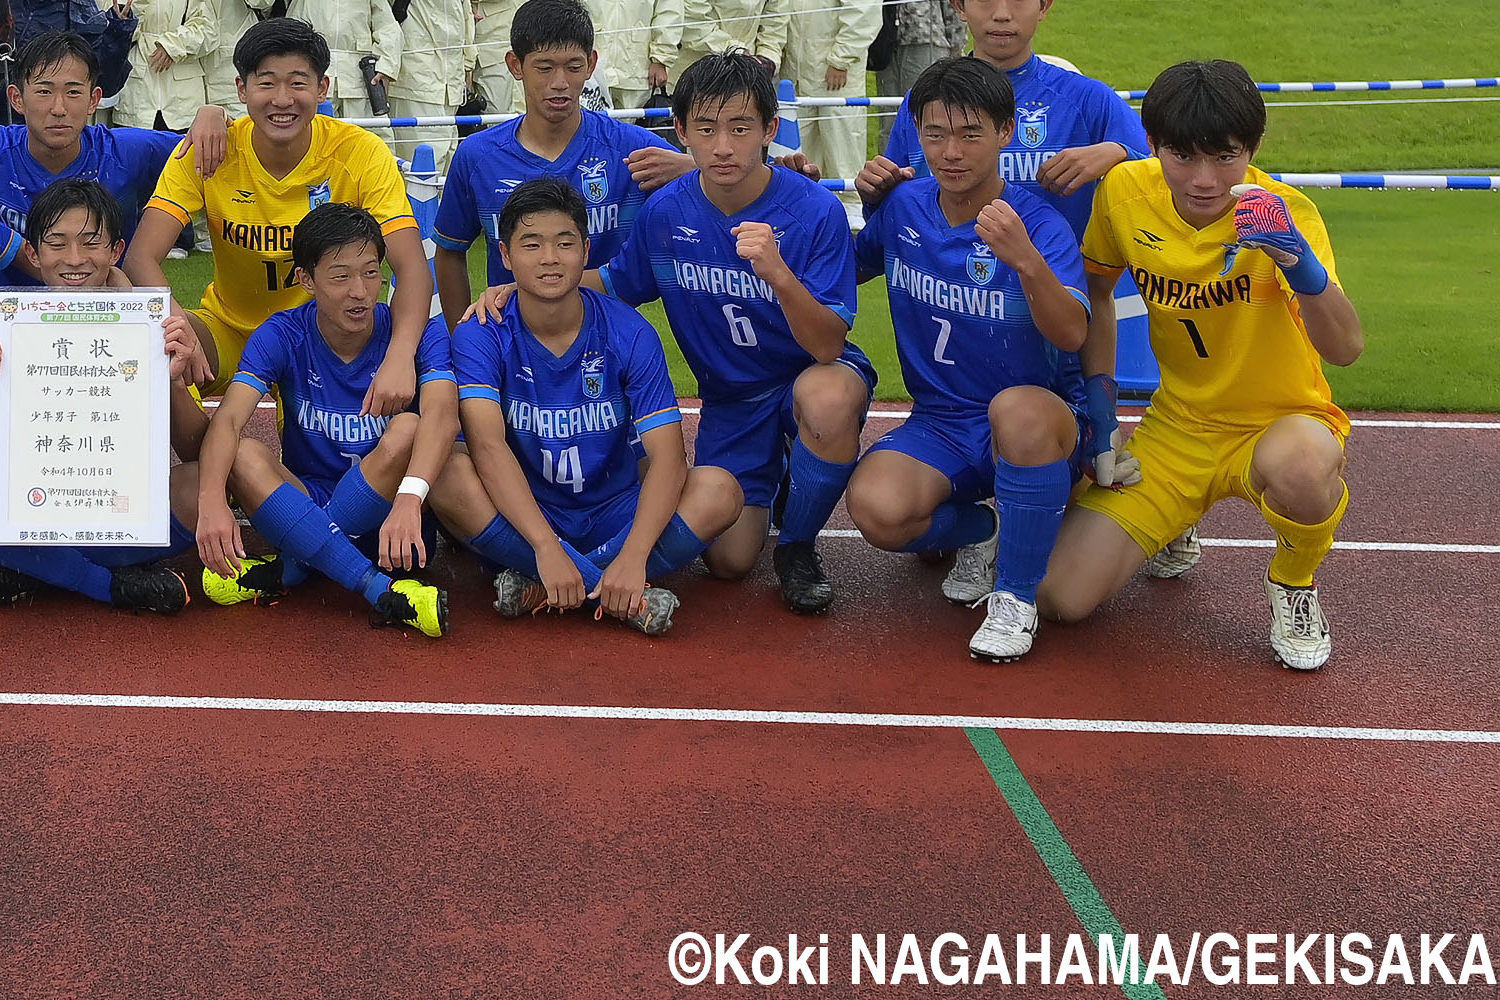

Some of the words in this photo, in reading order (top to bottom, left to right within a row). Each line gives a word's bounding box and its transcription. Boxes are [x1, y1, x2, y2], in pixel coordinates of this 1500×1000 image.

[222, 218, 299, 252] KANAG
[672, 235, 701, 243] PENALTY
[261, 259, 301, 292] 12
[673, 259, 780, 304] KANAGAW
[891, 258, 1005, 320] KANAGAWA
[20, 300, 116, 312] いちご一会とちぎ国体
[120, 302, 144, 311] 2022
[72, 313, 115, 322] 国民体育大会
[722, 303, 758, 347] 6
[52, 338, 114, 360] 賞状
[931, 315, 955, 365] 2
[1177, 318, 1209, 358] 1
[26, 364, 119, 377] 第77回国民体育大会
[41, 386, 112, 397] サッカー競技
[30, 411, 78, 423] 少年男子
[90, 411, 121, 423] 第1位
[298, 400, 391, 442] KANAGAW
[506, 399, 618, 439] KANAGAWA
[34, 434, 115, 454] 神奈川県
[41, 466, 113, 477] 令和4年10月6日
[540, 445, 586, 494] 14
[47, 487, 119, 498] 第77回国民体育大会
[19, 530, 140, 542] 夢を感動へ。感動を未来へ。
